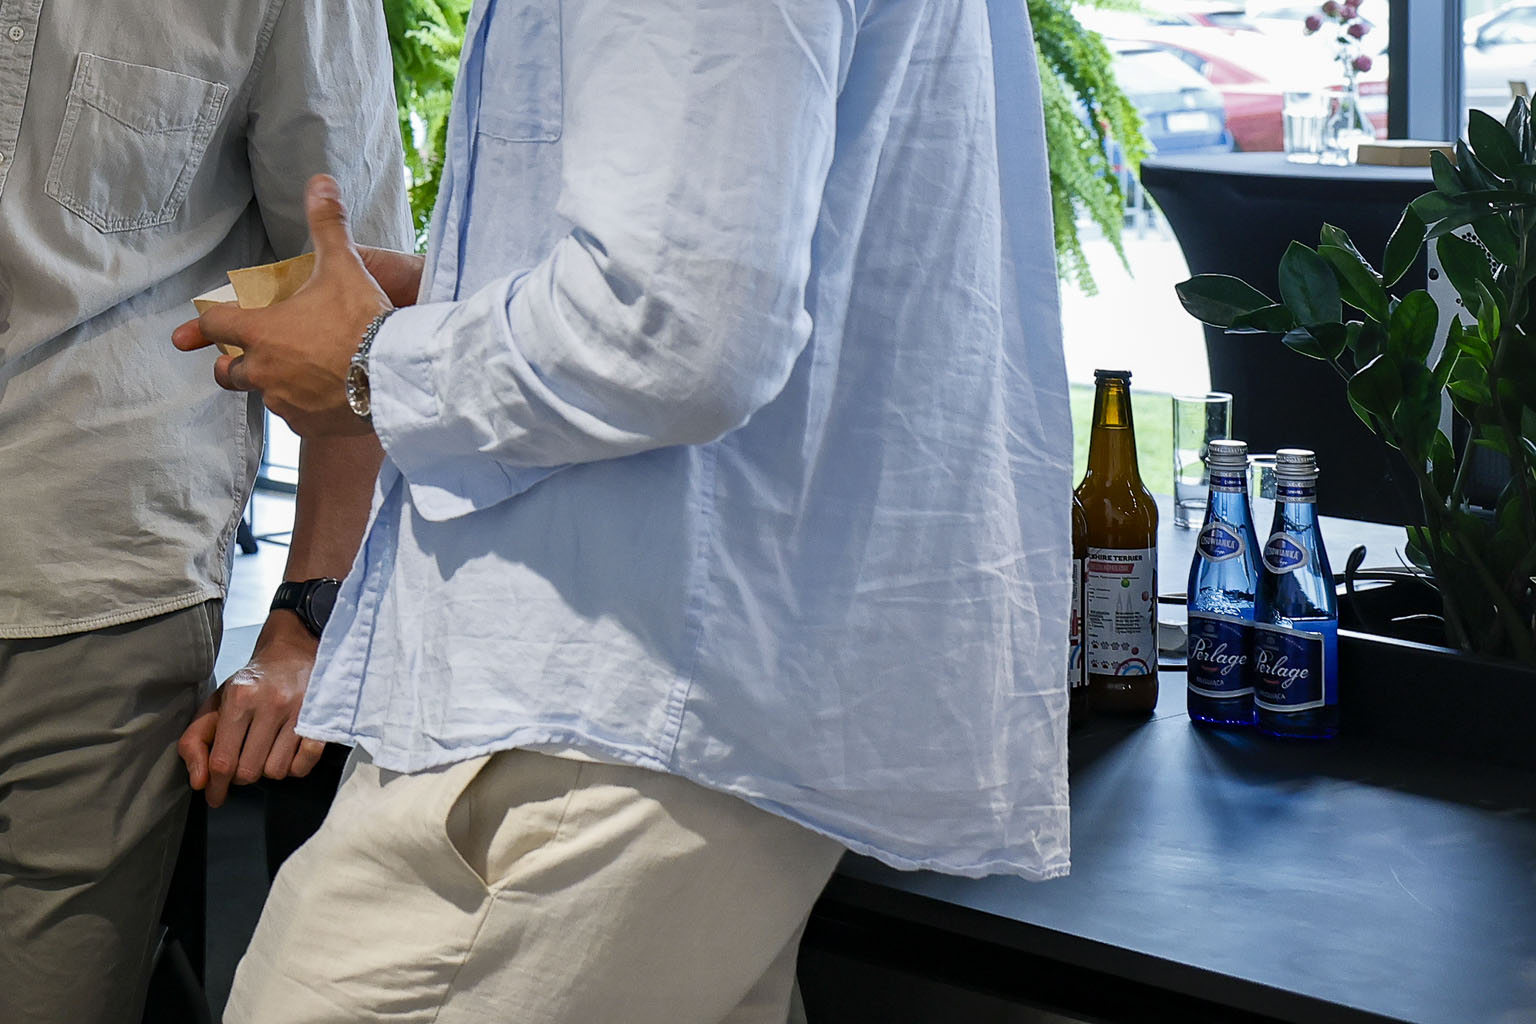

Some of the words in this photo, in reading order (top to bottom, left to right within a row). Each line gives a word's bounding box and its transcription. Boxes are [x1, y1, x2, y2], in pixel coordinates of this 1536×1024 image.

[1113, 554, 1143, 562] TERRIER
[1190, 637, 1247, 676] Perlage
[1255, 649, 1309, 689] Perlage
